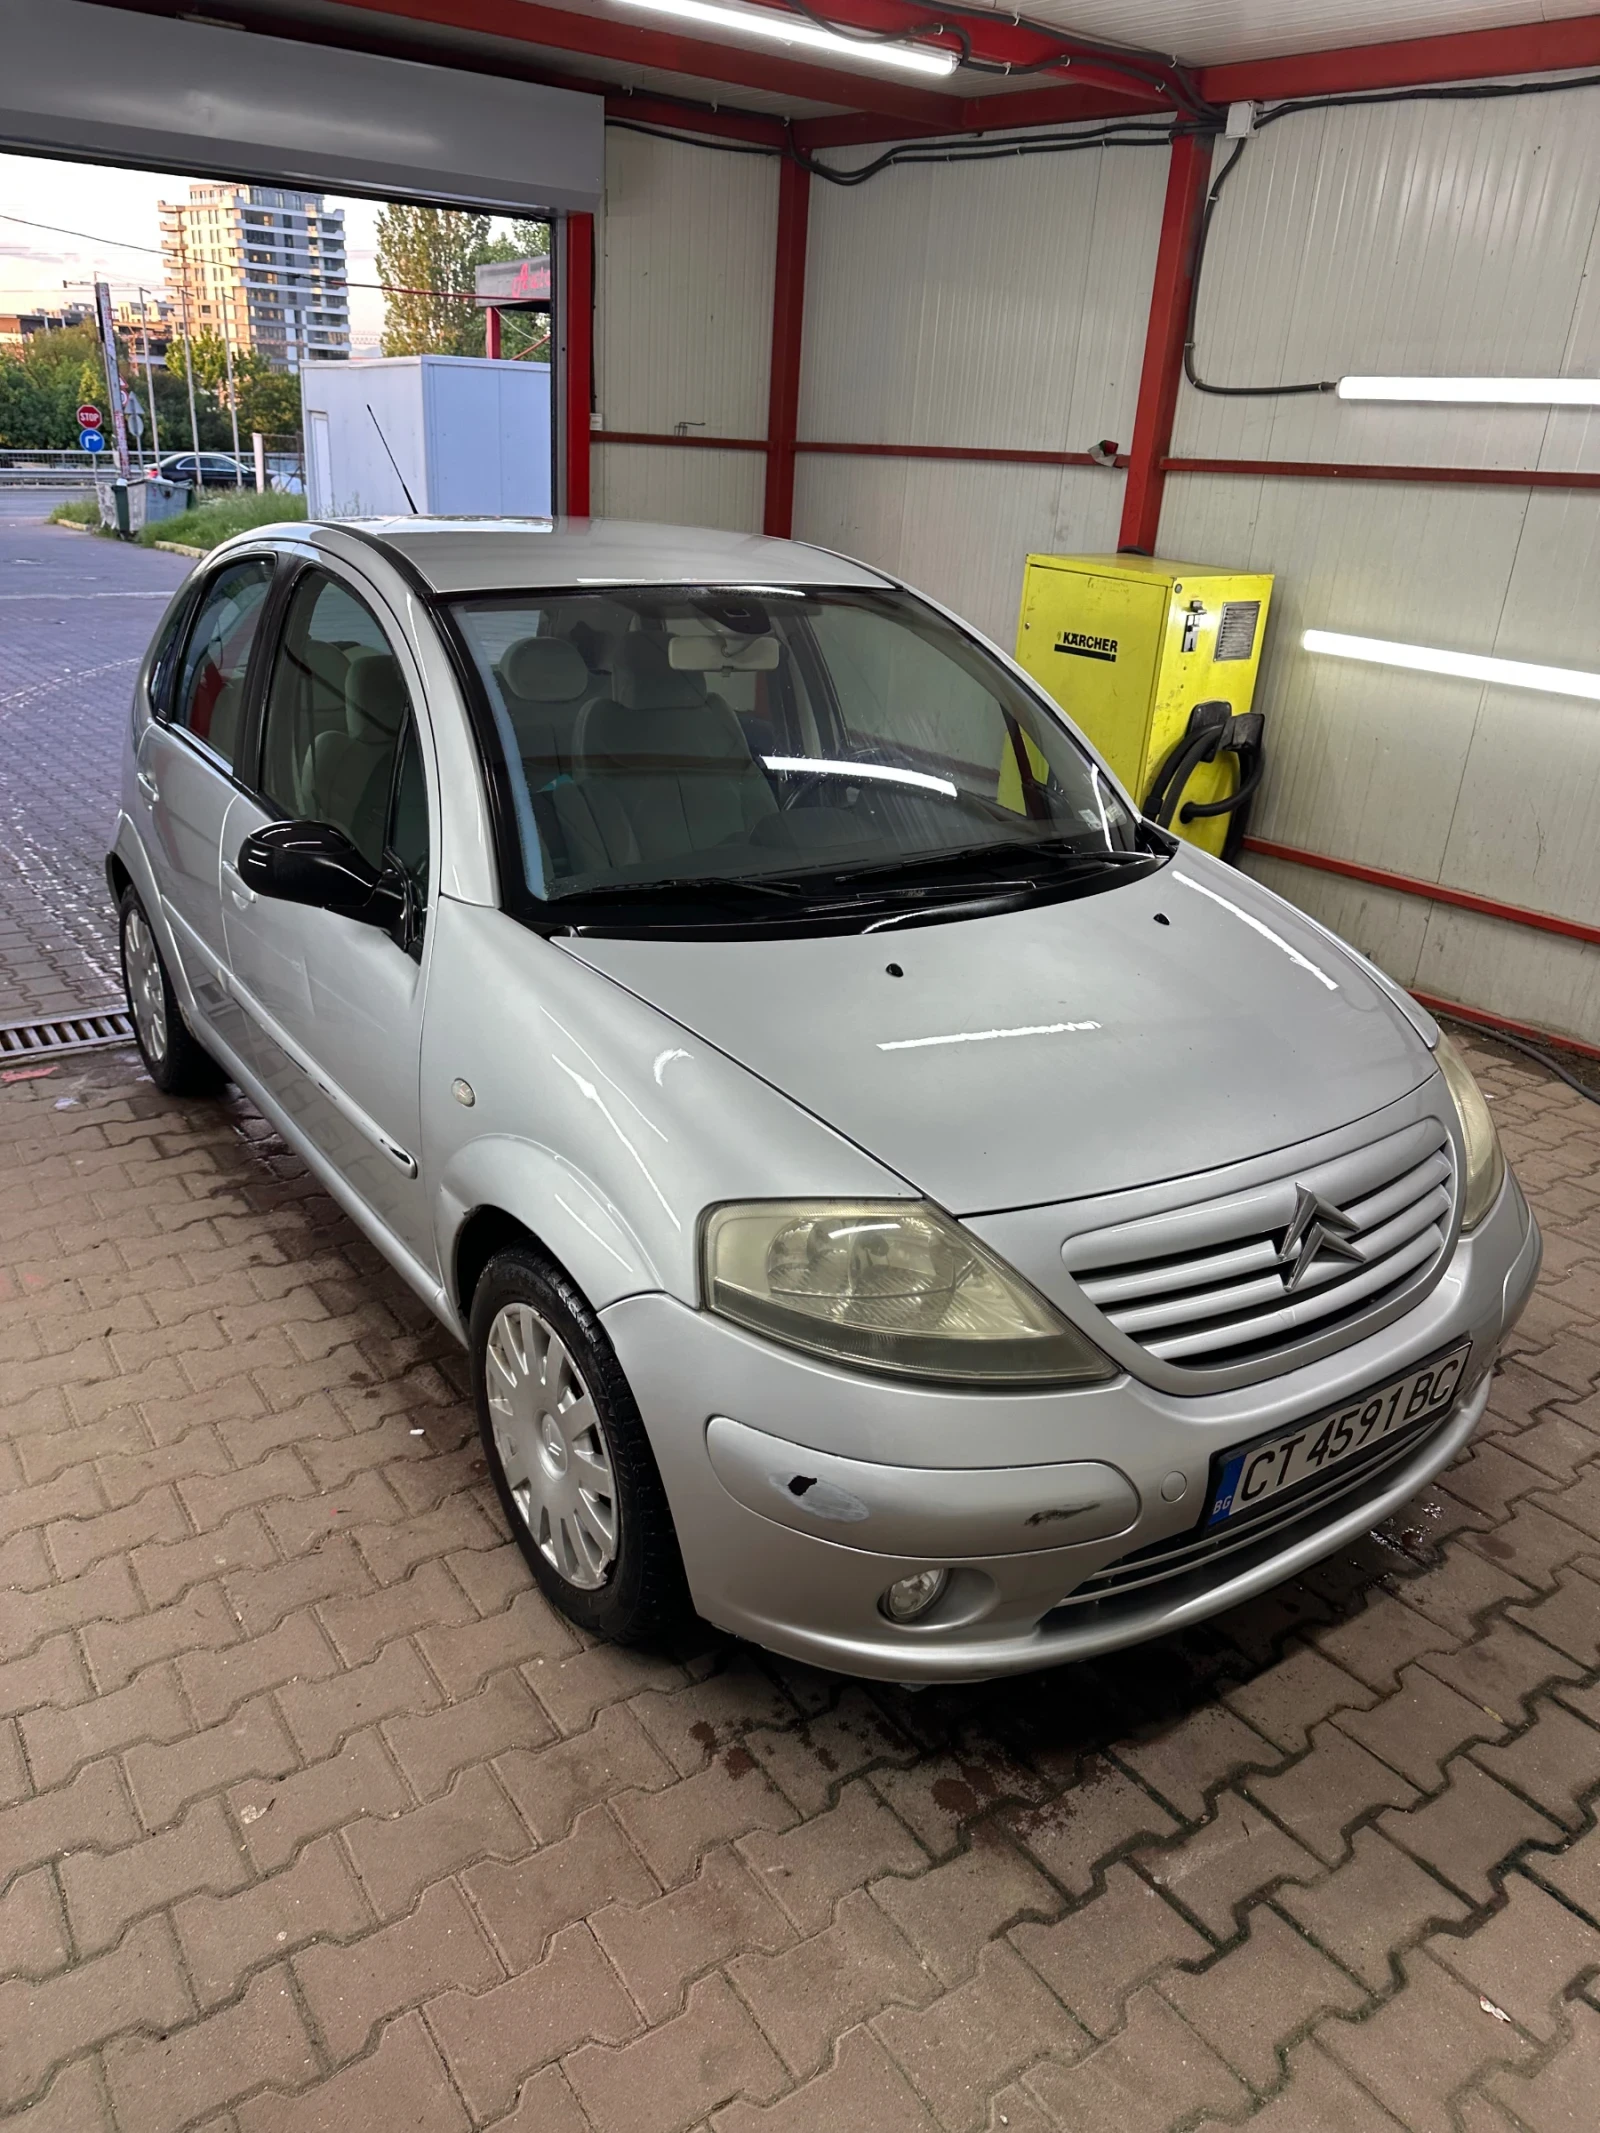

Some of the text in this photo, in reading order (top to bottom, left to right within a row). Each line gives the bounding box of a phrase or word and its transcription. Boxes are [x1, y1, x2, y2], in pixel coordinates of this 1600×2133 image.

[80, 412, 99, 422] STOP
[1063, 632, 1118, 653] KÄRCHER
[1241, 1359, 1458, 1501] CT 4591 BC
[1213, 1495, 1232, 1515] BG
